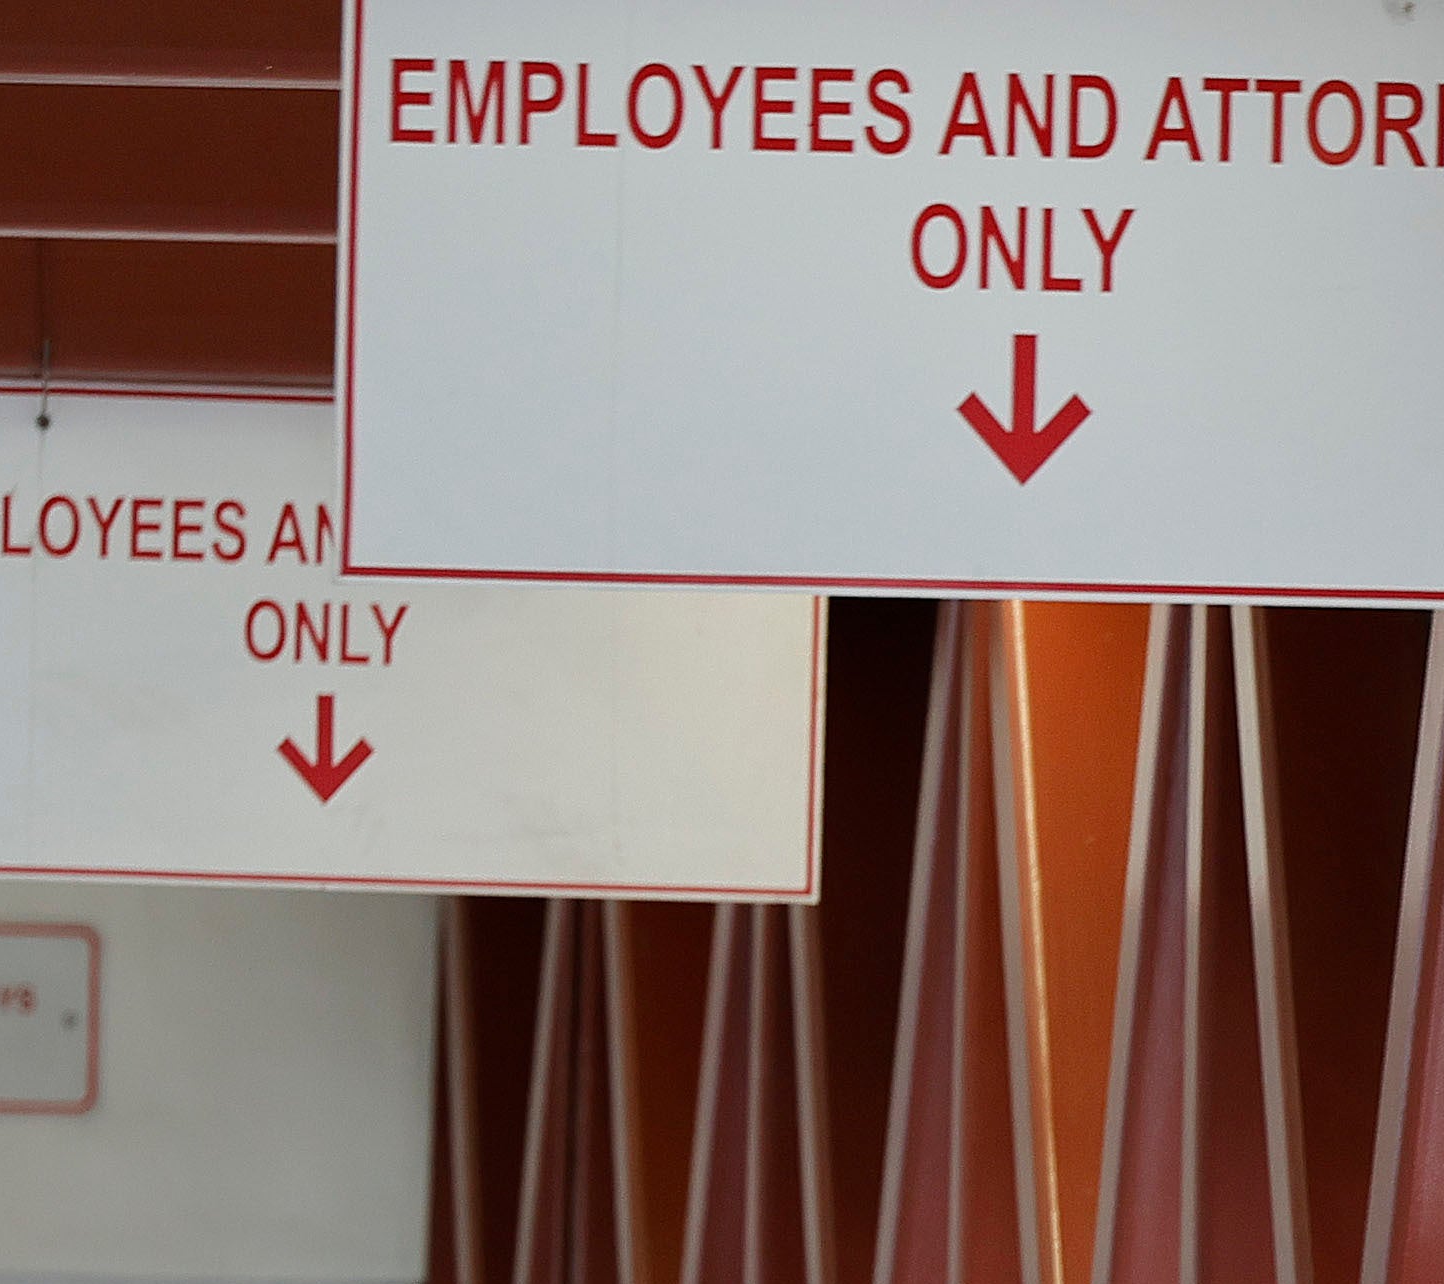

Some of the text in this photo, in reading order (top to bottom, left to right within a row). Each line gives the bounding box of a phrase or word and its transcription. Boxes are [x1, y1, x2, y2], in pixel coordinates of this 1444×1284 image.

[389, 57, 913, 156] EMPLOYEES
[939, 71, 1119, 160] AND
[910, 202, 1135, 293] ONLY
[243, 599, 410, 666] ONLY
